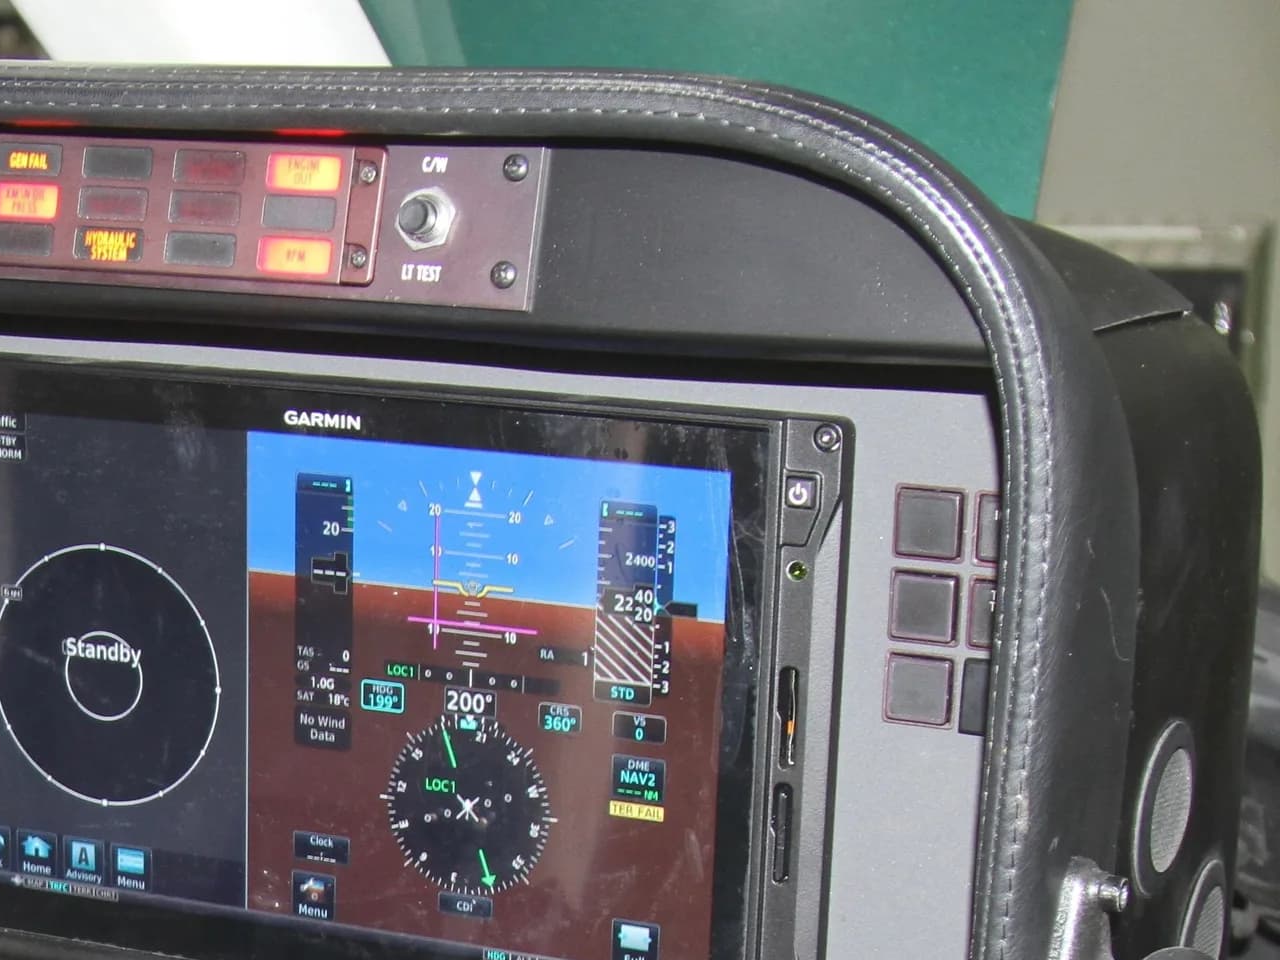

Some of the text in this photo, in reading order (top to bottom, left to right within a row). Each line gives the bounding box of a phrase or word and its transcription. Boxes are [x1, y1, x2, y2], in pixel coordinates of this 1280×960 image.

[29, 153, 48, 170] FAIL
[422, 157, 449, 172] C/W
[85, 231, 136, 248] HYDRAULIC
[91, 248, 127, 261] SYSTEM
[402, 264, 442, 282] LT TEST
[284, 410, 361, 430] GARMIN
[323, 521, 339, 536] 20
[625, 553, 655, 568] 2400
[66, 637, 141, 667] Standby
[311, 676, 334, 690] 1.0G
[610, 686, 634, 699] STD
[300, 713, 345, 730] No Wind
[310, 730, 335, 742] Data
[425, 777, 456, 793] LOC1
[620, 771, 656, 786] NAV2
[612, 804, 661, 820] TER FAIL
[310, 836, 334, 848] Clock
[23, 861, 51, 874] Home
[66, 869, 102, 885] Advisory
[118, 876, 145, 890] Menu
[298, 904, 328, 919] Menu
